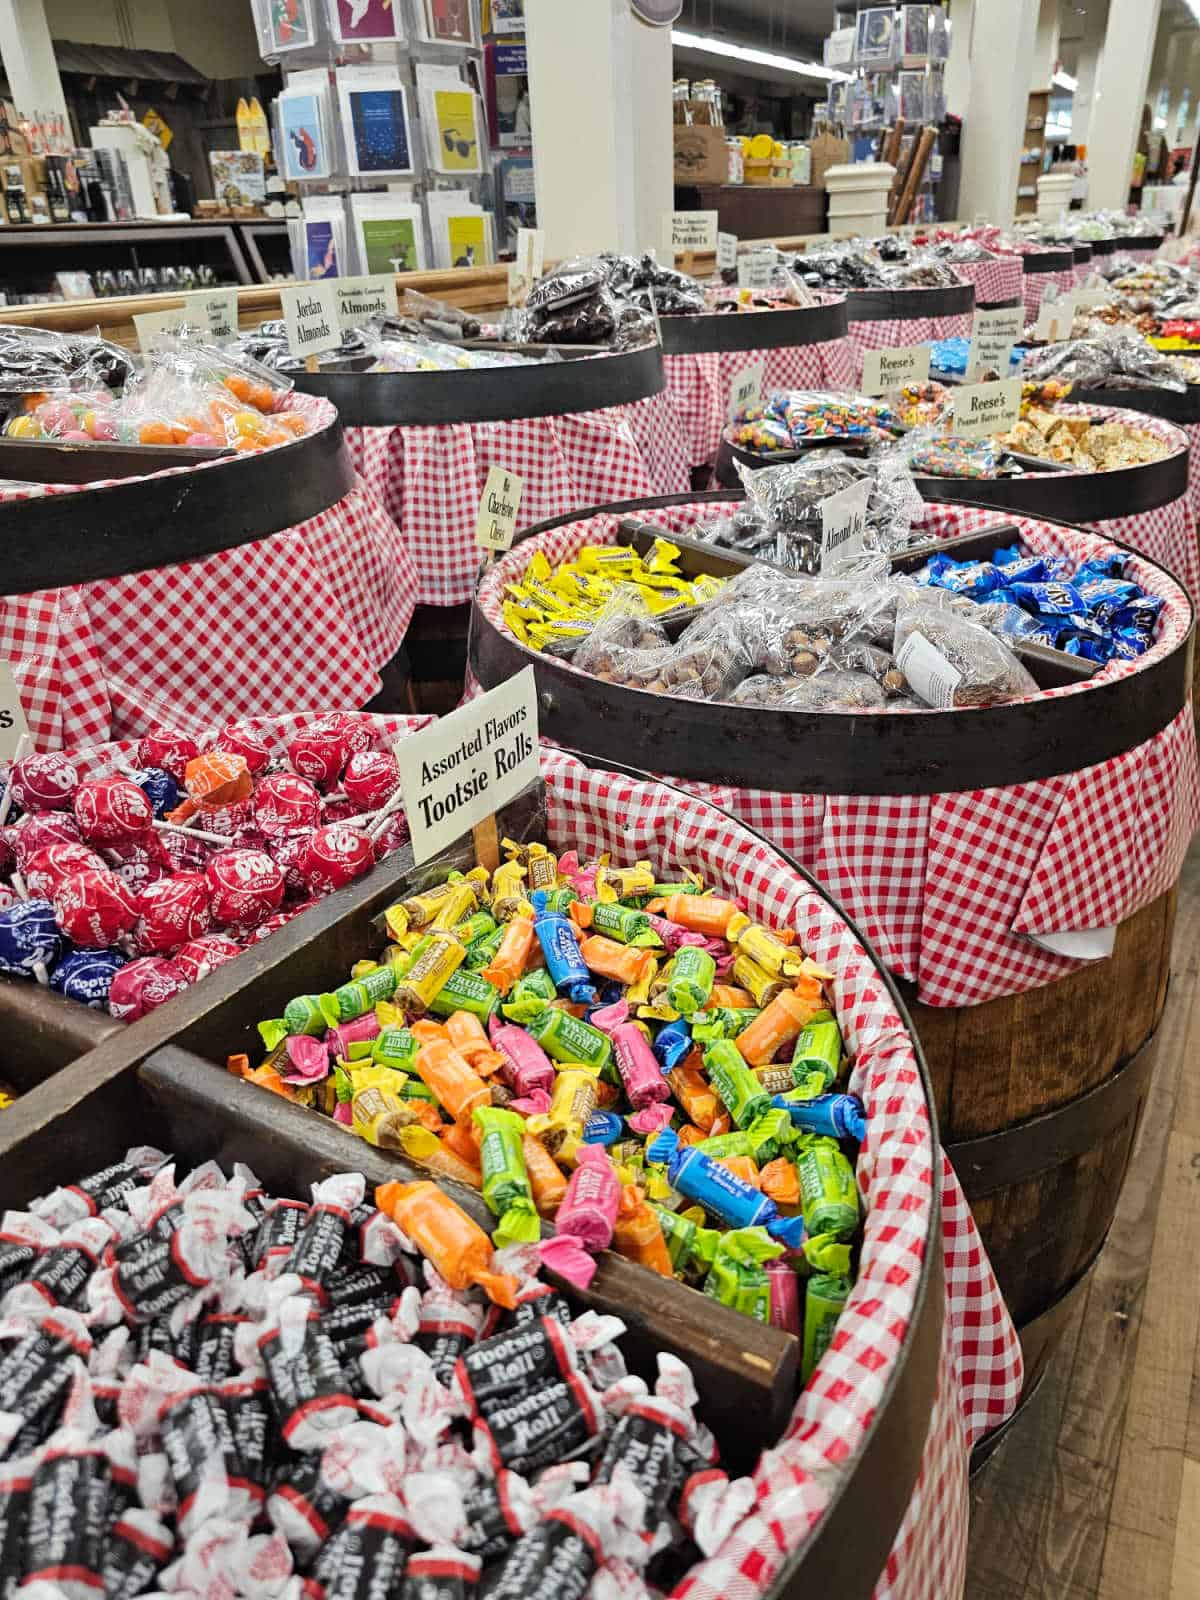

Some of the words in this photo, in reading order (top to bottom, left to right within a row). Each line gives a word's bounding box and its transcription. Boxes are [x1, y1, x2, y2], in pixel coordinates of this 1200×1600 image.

[297, 297, 322, 318] Jordan
[341, 298, 386, 314] Almonds
[297, 320, 330, 344] Almonds
[879, 355, 915, 369] Reese's
[971, 394, 1006, 411] Reese's
[826, 521, 851, 552] Almond
[421, 728, 482, 787] Assorted
[485, 705, 527, 747] Flavors
[418, 767, 489, 829] Tootsie
[494, 732, 533, 780] Rolls
[235, 854, 275, 881] POP
[567, 1026, 597, 1053] FRUIT
[763, 1070, 792, 1082] FRU
[763, 1080, 792, 1092] CHE
[277, 1208, 299, 1244] Tootsie
[297, 1214, 335, 1274] Tootsie
[321, 1233, 344, 1273] Roll
[40, 1249, 81, 1286] Tootsie
[60, 1265, 87, 1295] Roll
[133, 1264, 164, 1291] Roll
[466, 1331, 544, 1370] Tootsie
[489, 1351, 536, 1385] Roll
[489, 1382, 568, 1429] Tootsie
[513, 1405, 561, 1449] Roll
[624, 1439, 650, 1471] Ro
